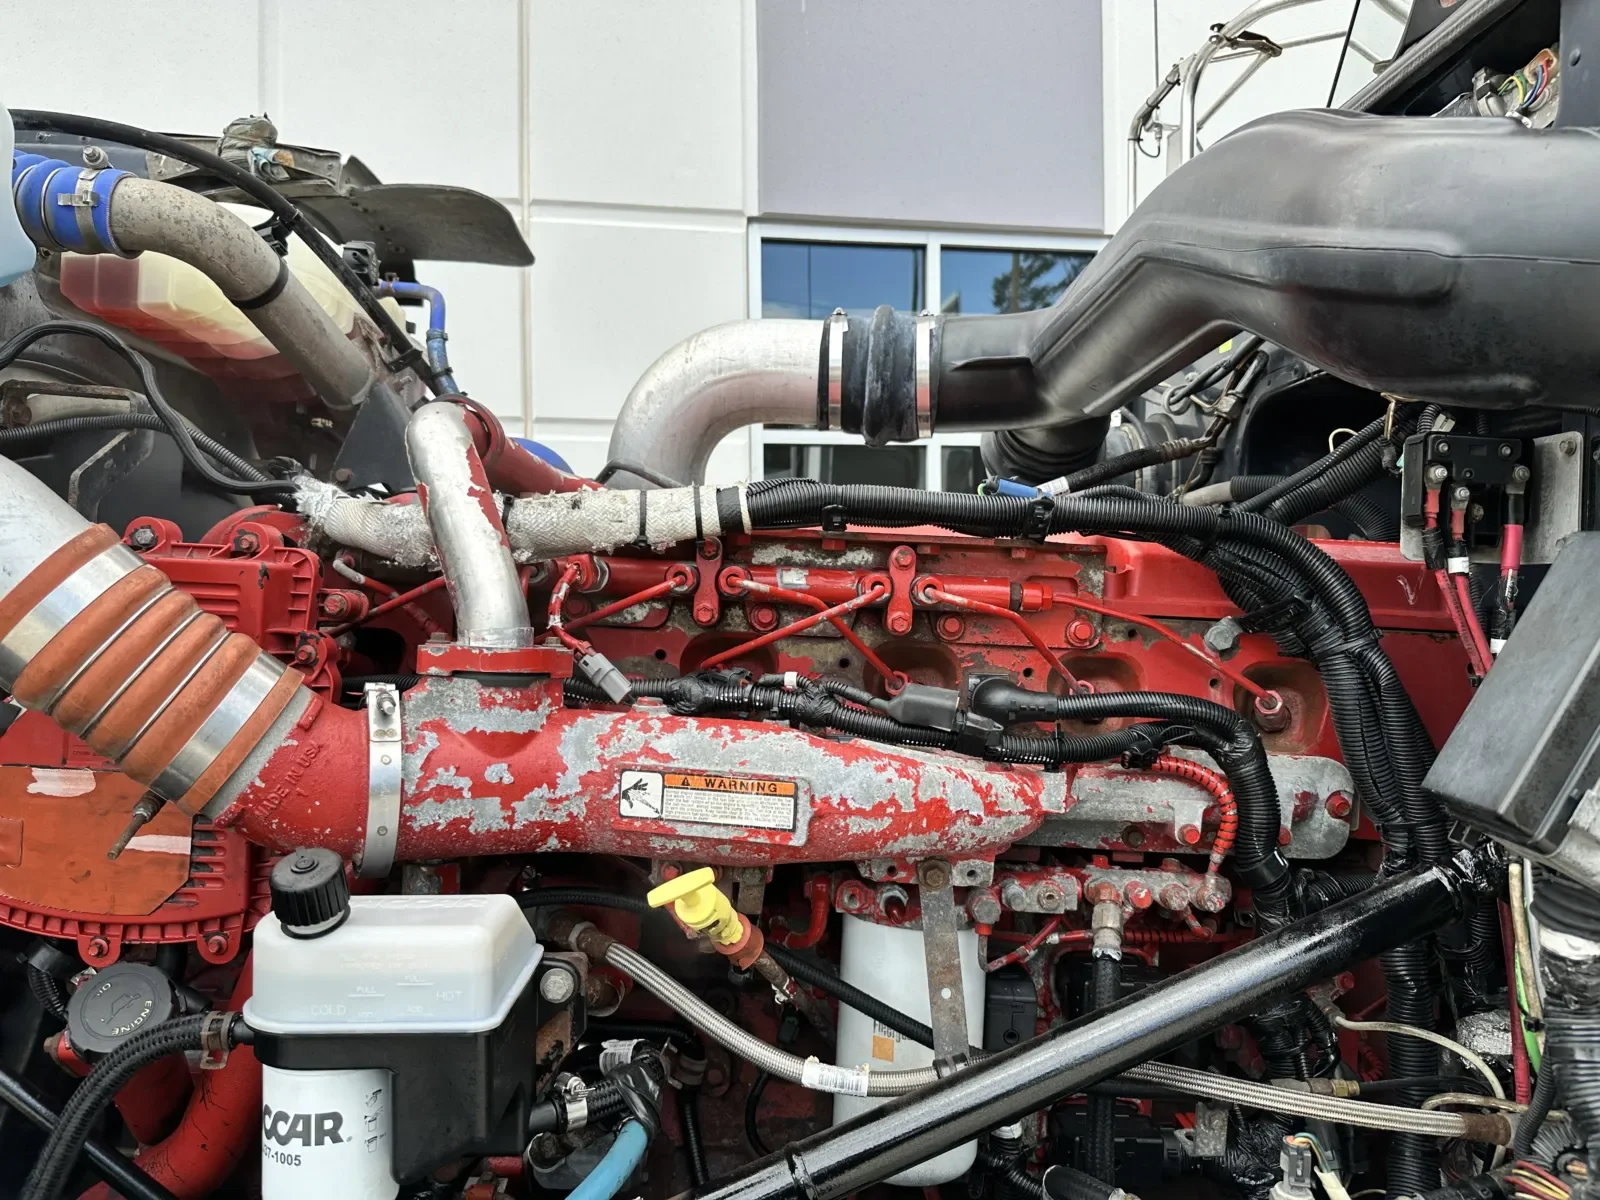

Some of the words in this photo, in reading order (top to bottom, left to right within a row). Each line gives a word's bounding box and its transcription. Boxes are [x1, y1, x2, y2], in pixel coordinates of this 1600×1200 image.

[254, 784, 289, 819] MADE
[284, 770, 301, 786] IN
[298, 739, 325, 769] USA
[704, 778, 778, 793] WARNING
[436, 990, 463, 1002] HOT
[111, 1000, 153, 1036] ENGINE
[310, 1003, 347, 1017] COLD
[263, 1103, 345, 1147] CCAR
[263, 1144, 302, 1167] 37-1005
